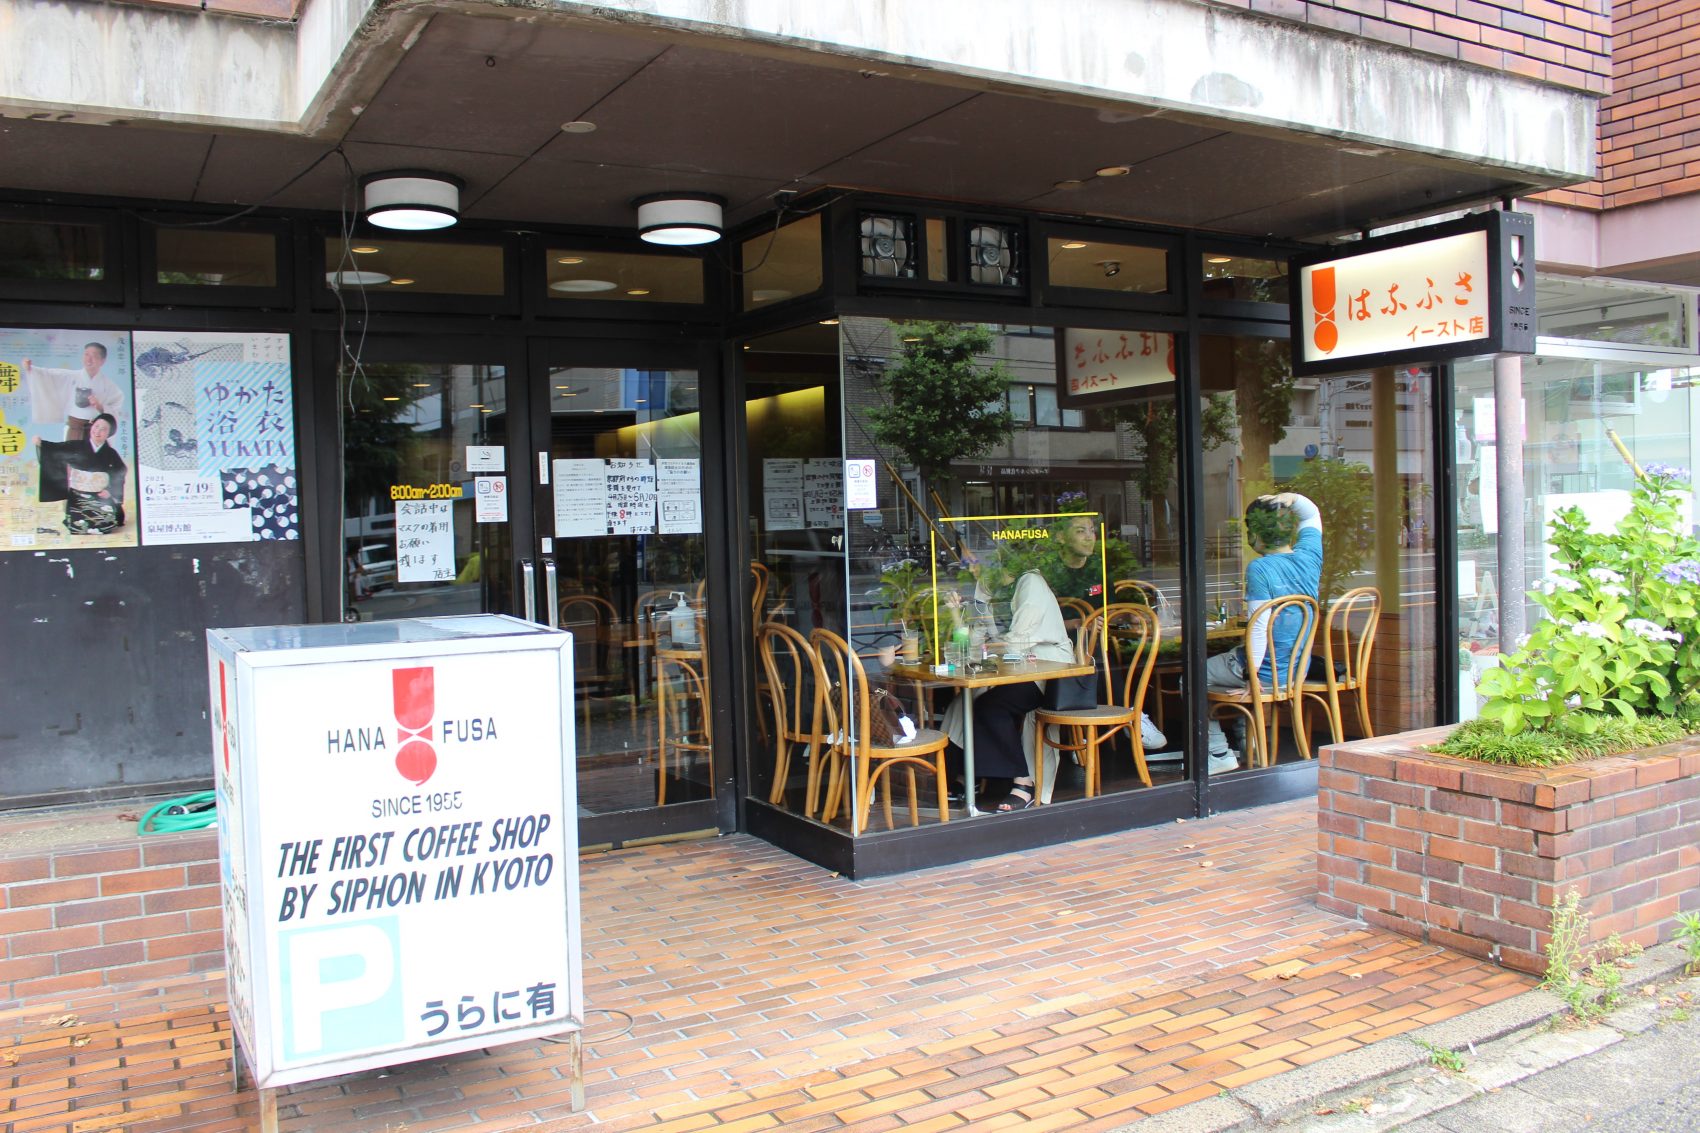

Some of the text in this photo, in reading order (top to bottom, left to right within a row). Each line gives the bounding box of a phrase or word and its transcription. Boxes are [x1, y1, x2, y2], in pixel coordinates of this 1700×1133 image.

[1509, 306, 1531, 316] SINCE
[1406, 316, 1484, 342] イースト店
[204, 380, 284, 407] ゆかた
[207, 410, 286, 435] 浴衣
[208, 440, 287, 457] YUKATA
[610, 461, 645, 469] お知らせ
[401, 503, 448, 515] 会話中は
[398, 521, 449, 533] マスクの着用
[992, 529, 1049, 540] HANAFUSA
[328, 717, 498, 755] HANA FUSA
[372, 791, 463, 819] SINCE 1955
[278, 813, 552, 879] THE FIRST COFFEE SHOP
[278, 883, 318, 923] BY
[327, 872, 428, 917] SIPHON
[435, 865, 463, 900] IN
[472, 853, 554, 897] KYOTO
[289, 924, 395, 1054] P
[420, 982, 557, 1037] うらに有
